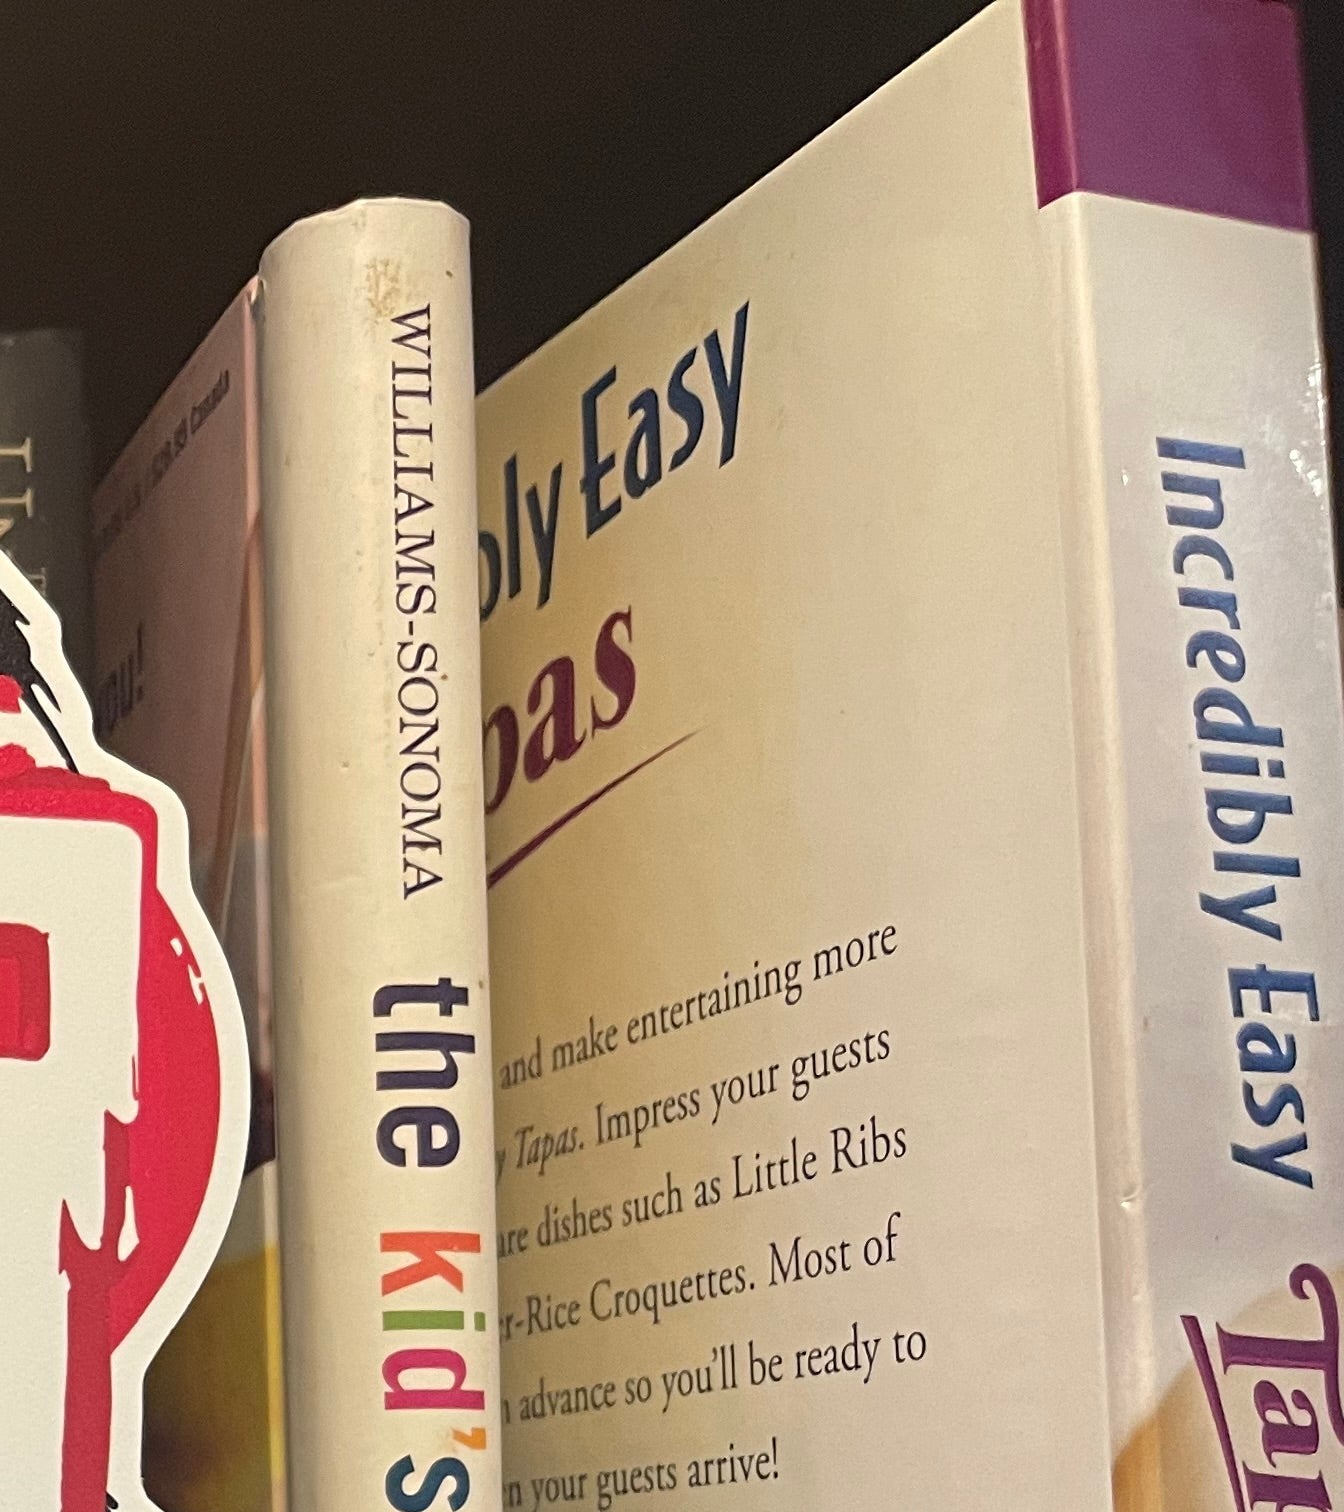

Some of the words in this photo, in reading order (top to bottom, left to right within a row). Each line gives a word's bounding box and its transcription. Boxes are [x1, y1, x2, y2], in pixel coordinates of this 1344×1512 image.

[578, 300, 750, 540] Easy
[390, 302, 444, 900] WILLIAMS-SONOMA
[1155, 435, 1302, 942] Incredibly
[372, 976, 476, 1168] the
[499, 1035, 543, 1091] and
[552, 1017, 619, 1074] make
[626, 959, 802, 1045] entertaining
[812, 923, 899, 982] more
[1226, 962, 1321, 1190] Easy
[514, 1123, 585, 1177] Tapas.
[595, 1086, 701, 1150] Impress
[710, 1061, 780, 1126] your
[790, 1028, 892, 1102] guests
[536, 1196, 613, 1247] dishes
[621, 1171, 684, 1229] such
[693, 1174, 722, 1208] as
[732, 1136, 818, 1200] Little
[830, 1114, 908, 1175] Ribs
[589, 1262, 756, 1325] Croquettes.
[767, 1235, 852, 1288] Most
[862, 1211, 902, 1267] of
[519, 1377, 617, 1422] advance
[623, 1373, 653, 1407] so
[661, 1343, 739, 1414] you'll
[747, 1339, 785, 1387] be
[793, 1321, 883, 1385] ready
[892, 1328, 927, 1365] to
[595, 1462, 678, 1512] guests
[686, 1436, 780, 1489] arrive!
